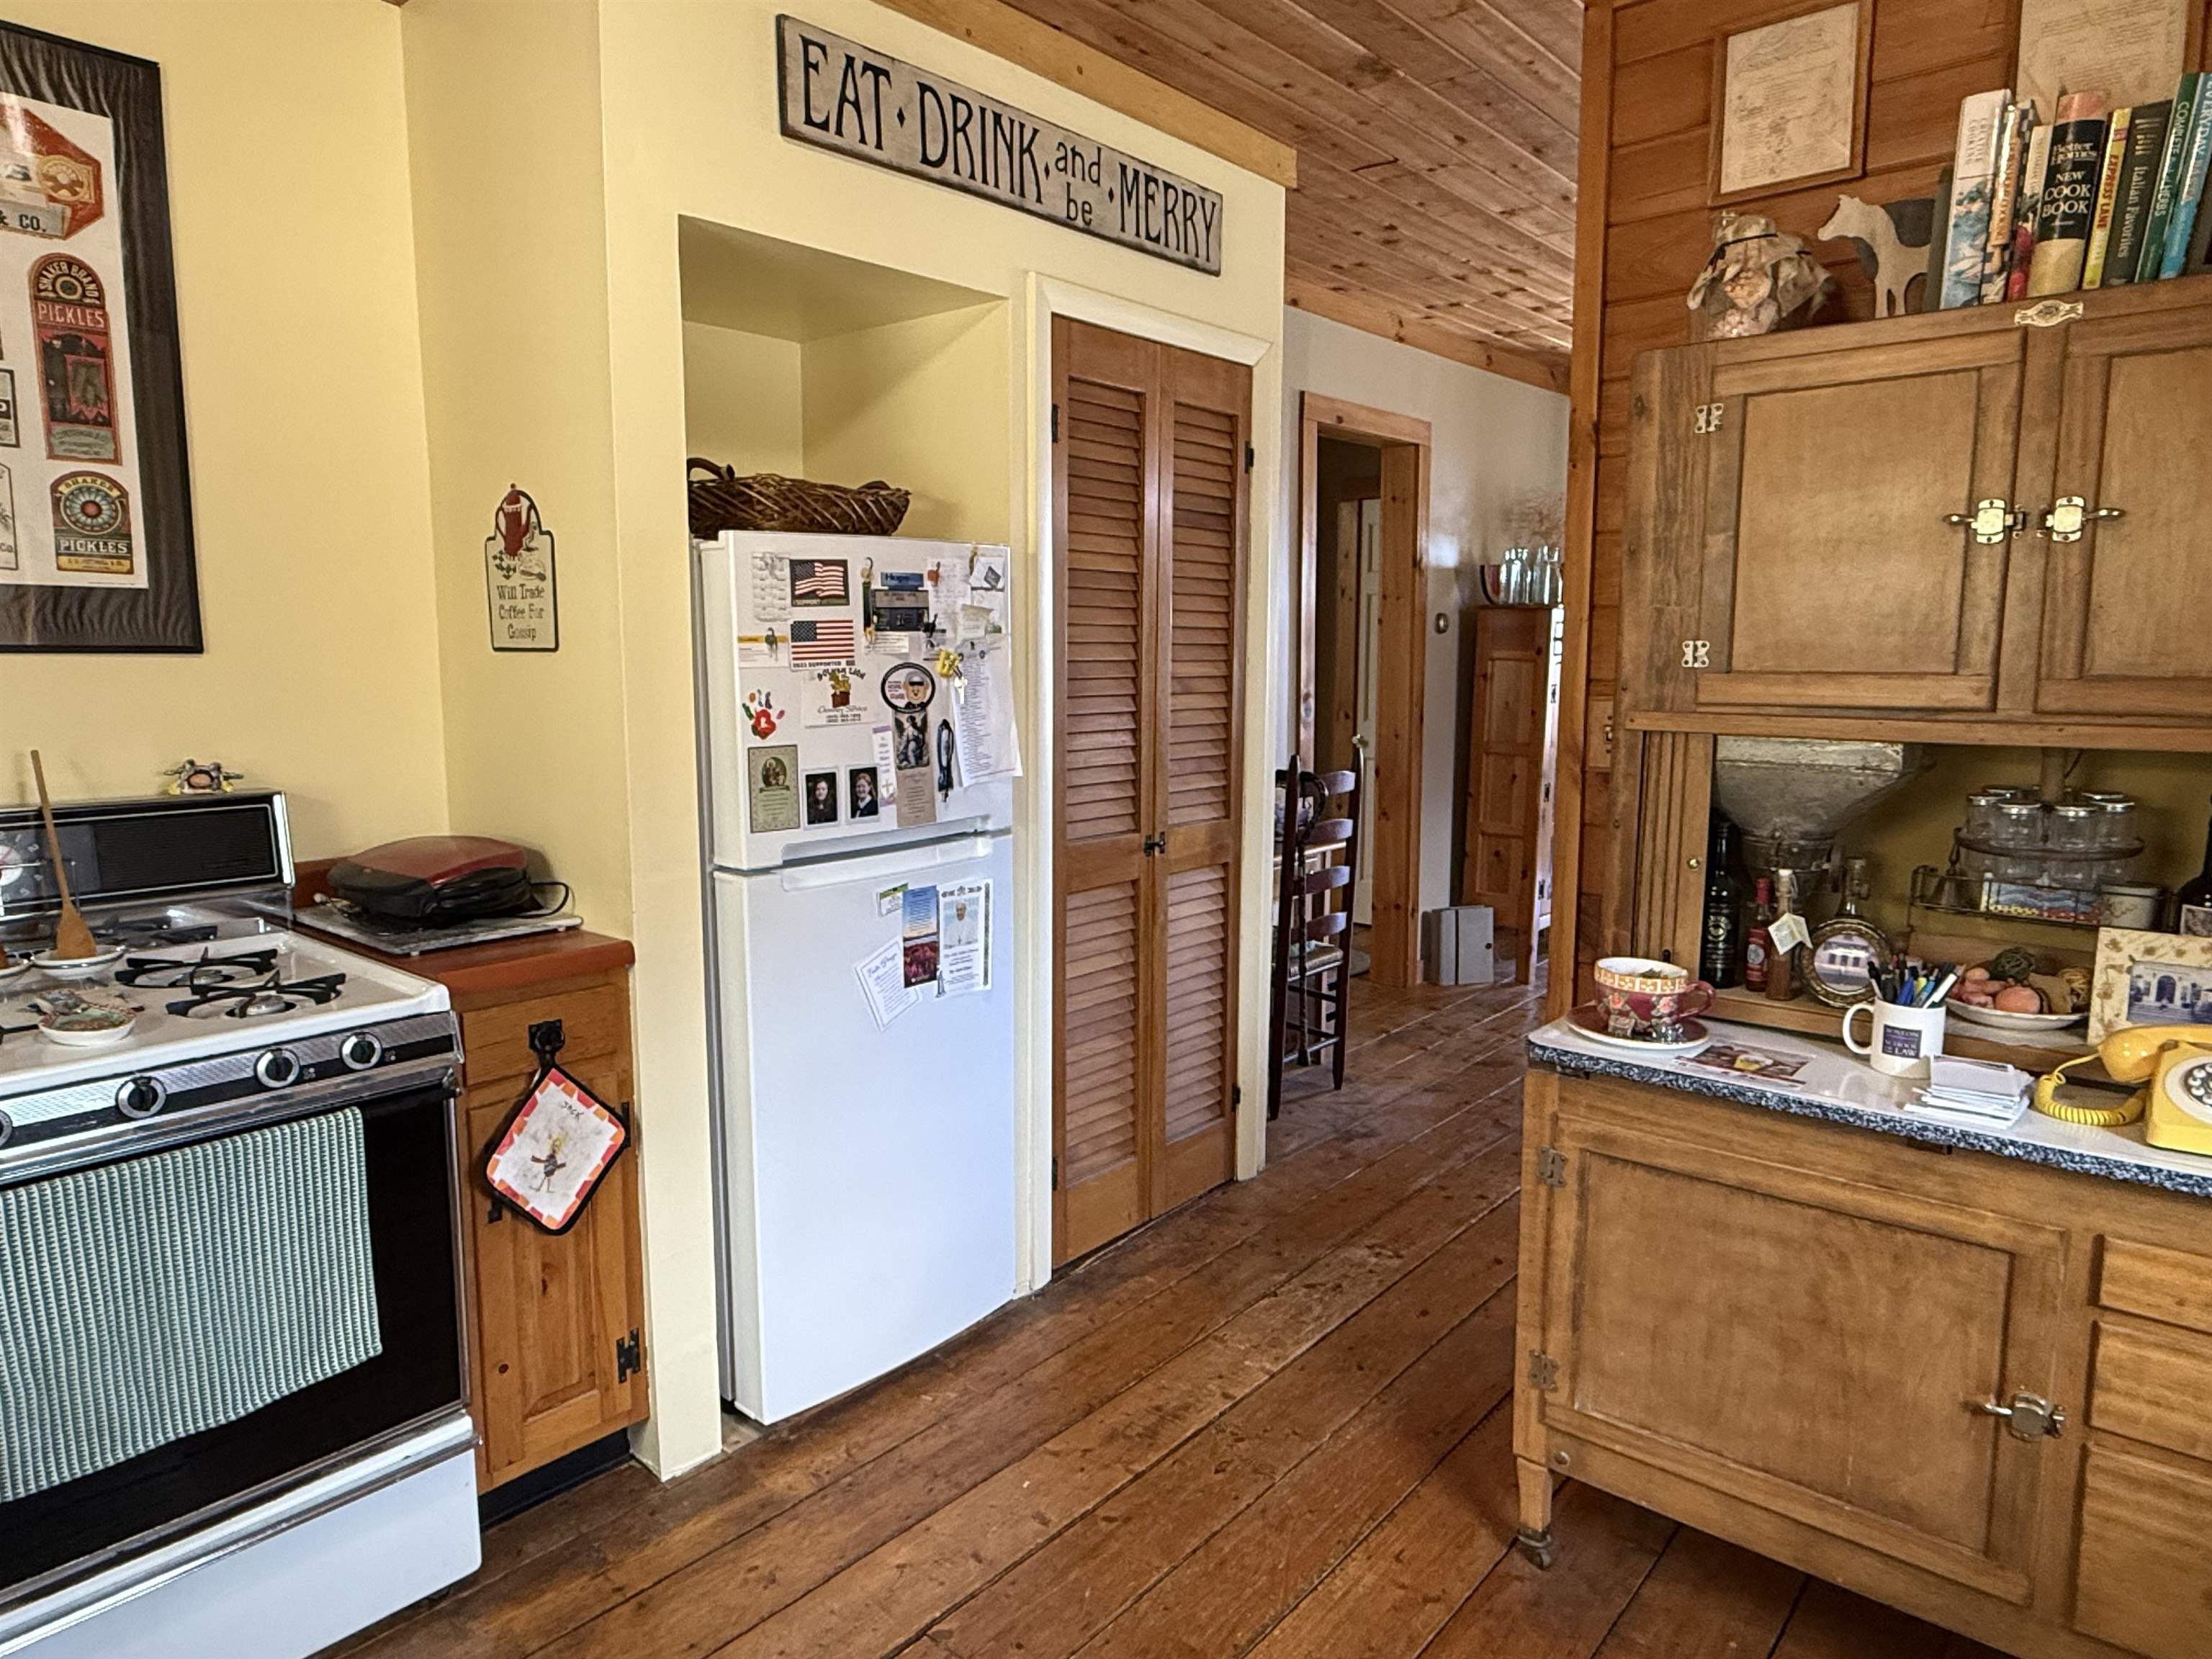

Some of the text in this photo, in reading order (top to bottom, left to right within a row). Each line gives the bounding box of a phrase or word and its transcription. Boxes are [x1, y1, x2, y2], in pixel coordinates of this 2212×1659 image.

[799, 34, 1217, 264] EAT DRINK and MERRY
[2056, 171, 2086, 183] NEW
[2100, 154, 2119, 199] EXPRESS
[2044, 184, 2091, 202] COOK
[1066, 181, 1093, 227] be
[2041, 200, 2088, 218] BOOK
[2117, 166, 2149, 258] Italian Favorites
[19, 213, 47, 233] CO.
[2097, 199, 2110, 229] LANE
[38, 261, 100, 298] SHAKER BRAND
[37, 301, 104, 328] PICKLES
[63, 477, 114, 493] SHAKER
[60, 539, 128, 554] PICKLES
[497, 583, 545, 600] Will Trade
[498, 603, 544, 621] Coffee For
[1894, 1047, 1917, 1056] LAW
